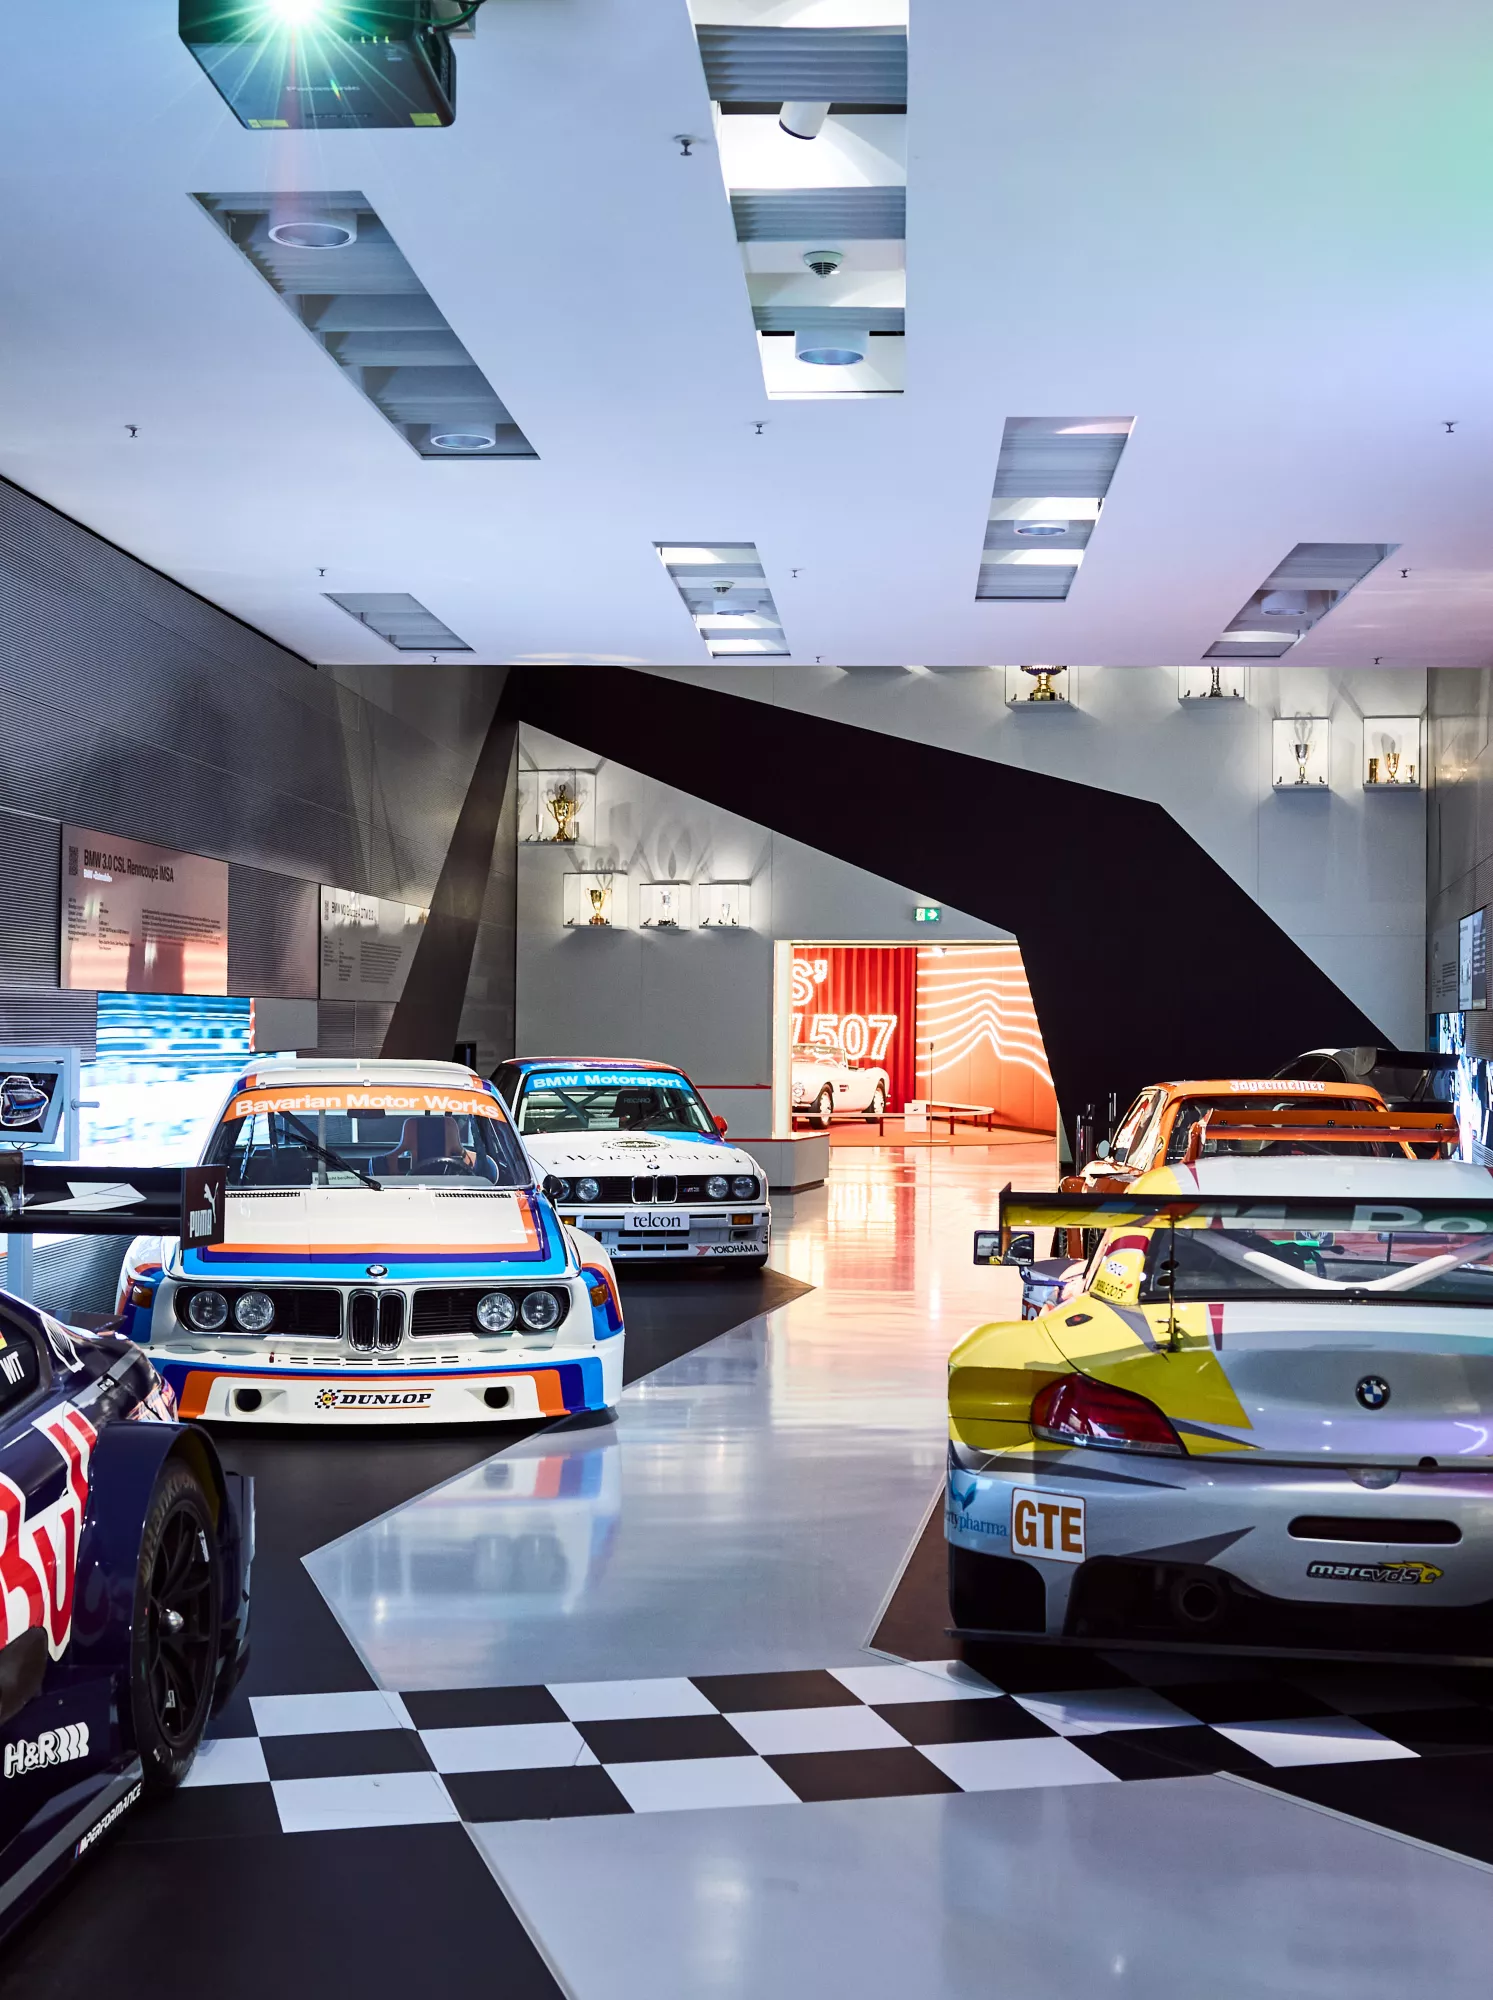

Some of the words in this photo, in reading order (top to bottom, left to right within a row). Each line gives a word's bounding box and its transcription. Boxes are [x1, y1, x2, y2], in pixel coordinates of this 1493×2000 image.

[83, 849, 102, 868] BMW
[102, 853, 112, 871] 3.0
[113, 855, 126, 874] CSL
[127, 859, 159, 882] Renncoupé
[160, 865, 174, 882] IMSA
[810, 1013, 898, 1060] 507
[533, 1075, 578, 1088] BMW
[584, 1074, 683, 1088] Motorsport
[235, 1093, 341, 1117] Bavarian
[346, 1093, 416, 1110] Motor
[423, 1095, 500, 1118] Works
[189, 1208, 213, 1239] PUMA
[633, 1212, 681, 1228] telcon
[711, 1243, 760, 1254] YOKOHAMA
[340, 1393, 432, 1405] DUNLOP
[1014, 1499, 1083, 1554] GTE
[4, 1730, 61, 1779] H&R
